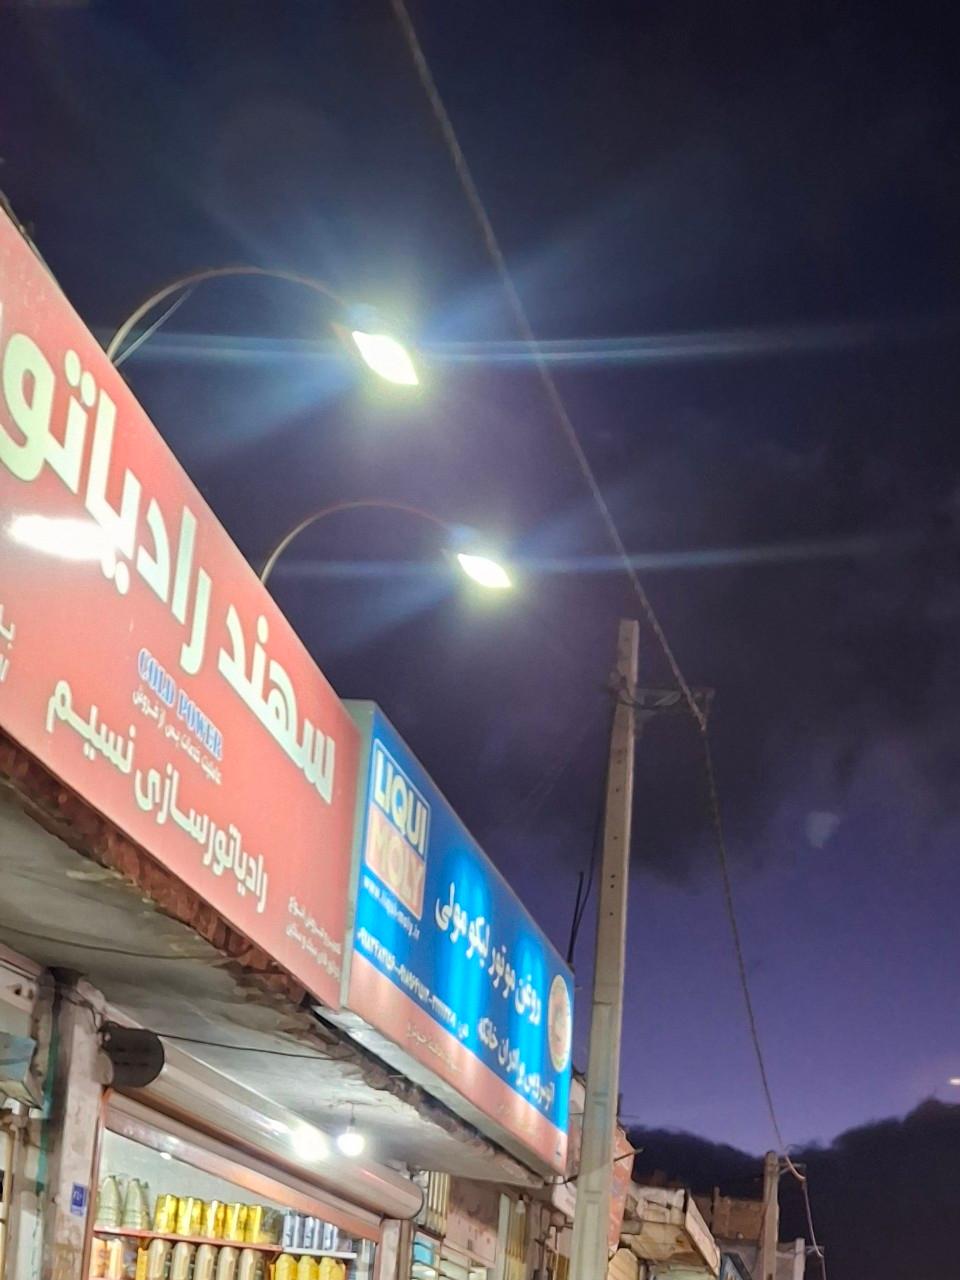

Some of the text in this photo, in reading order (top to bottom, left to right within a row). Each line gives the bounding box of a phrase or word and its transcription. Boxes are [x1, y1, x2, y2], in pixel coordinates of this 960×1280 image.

[0, 332, 335, 804] سهند رادیاتو
[46, 680, 136, 774] نسیم
[138, 648, 222, 761] COLD POWER
[374, 750, 428, 855] LIQUI
[370, 812, 425, 905] MOLY
[435, 881, 467, 943] مولی
[488, 944, 516, 998] موتور
[514, 974, 542, 1026] روغن
